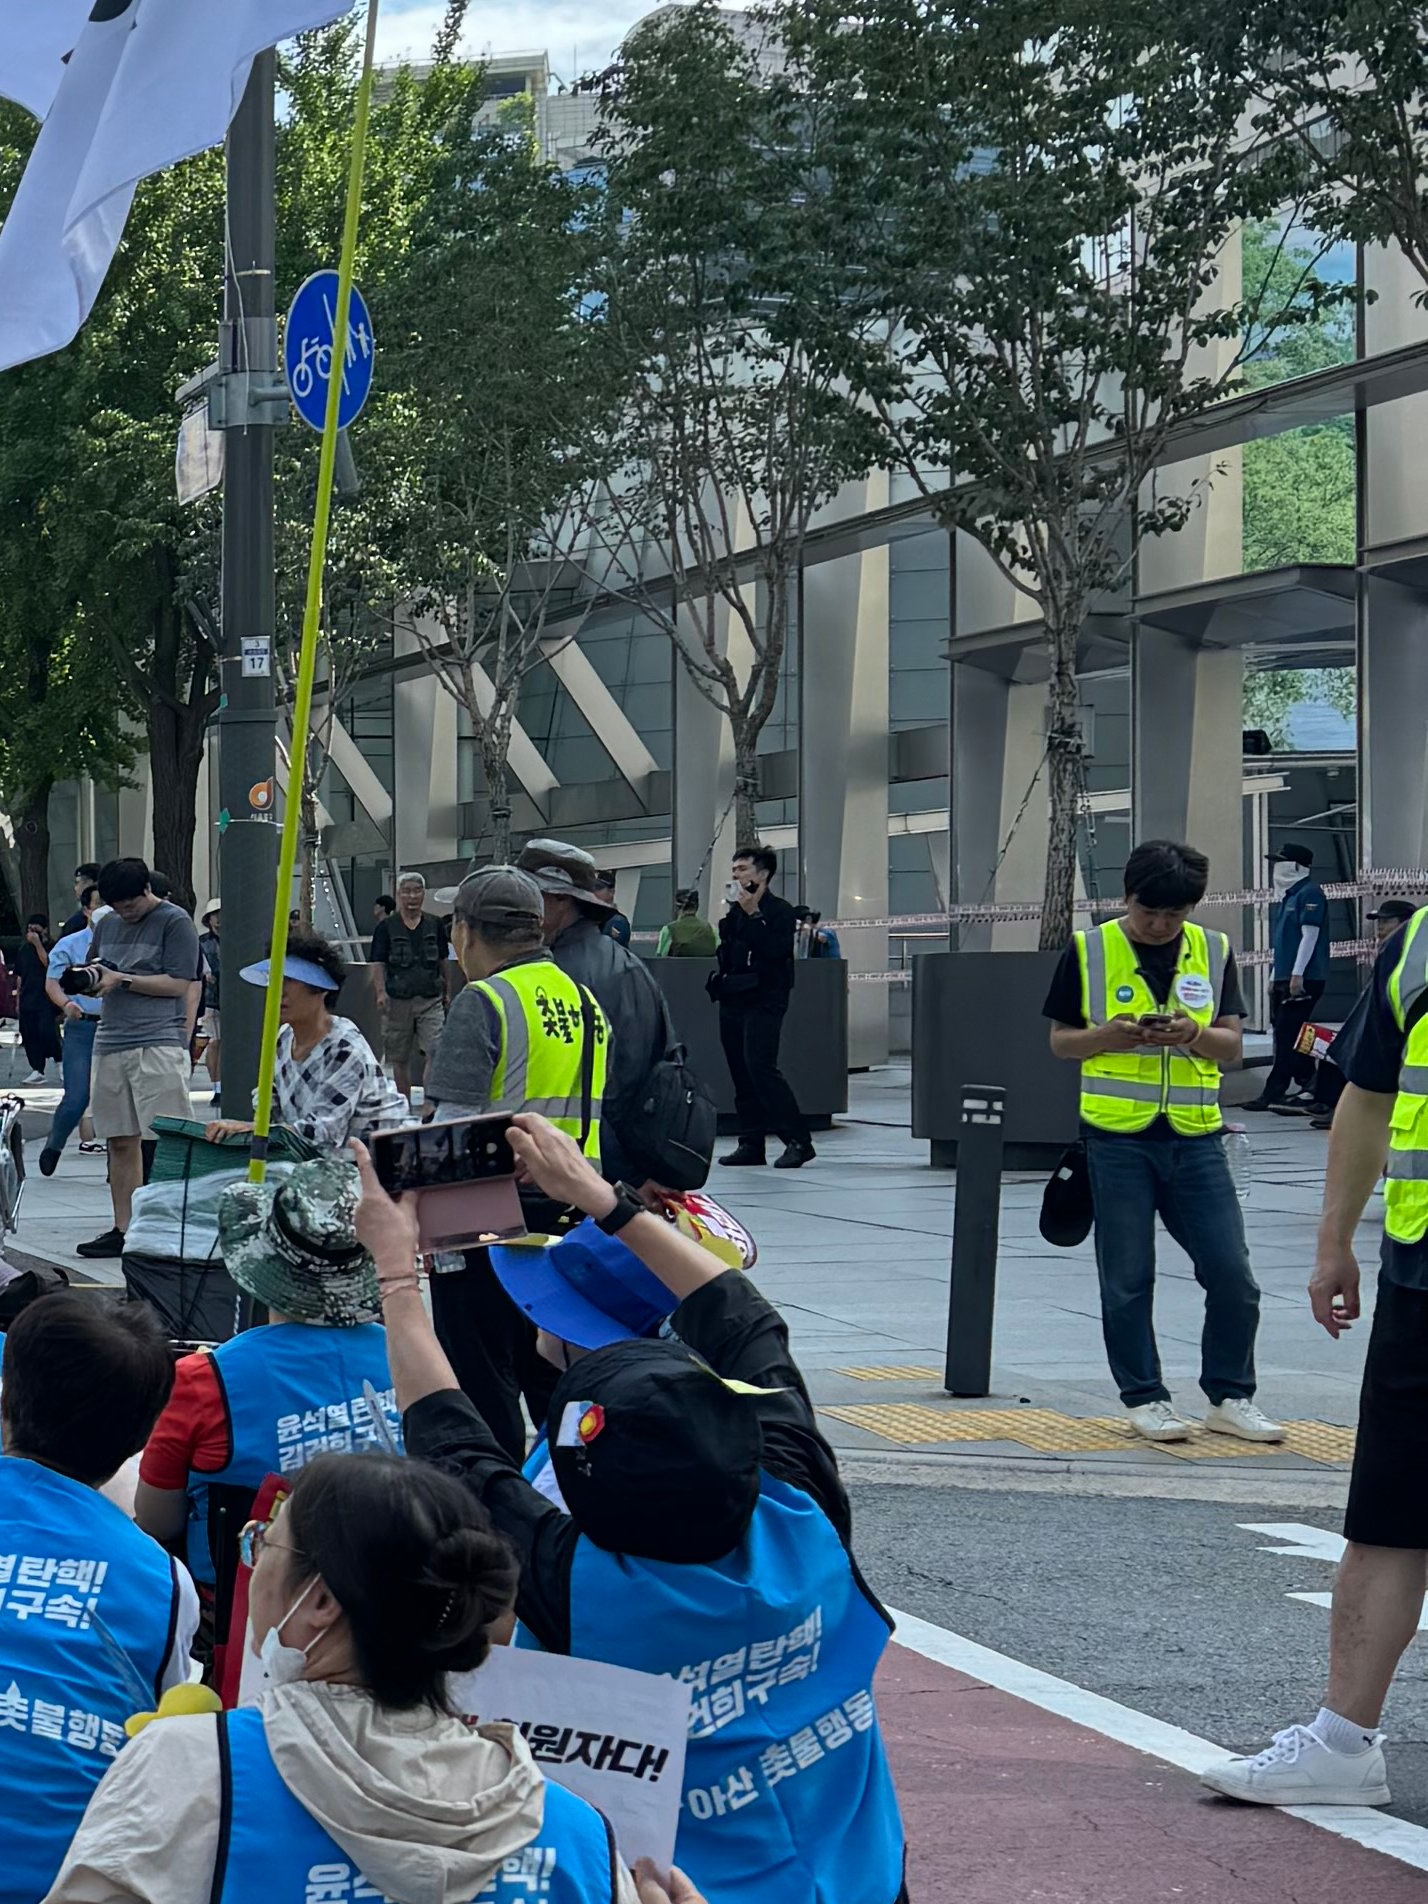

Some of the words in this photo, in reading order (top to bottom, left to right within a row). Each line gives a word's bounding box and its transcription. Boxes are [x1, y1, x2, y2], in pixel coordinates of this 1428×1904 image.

[277, 1402, 351, 1444] 윤석열
[20, 1558, 108, 1594] 탄핵!
[7, 1594, 98, 1630] 구속!
[664, 1645, 747, 1694] 석열
[749, 1605, 822, 1671] 탄핵!
[687, 1682, 746, 1740] 건희
[758, 1689, 874, 1788] 촛불행동
[479, 1846, 557, 1893] 핵!
